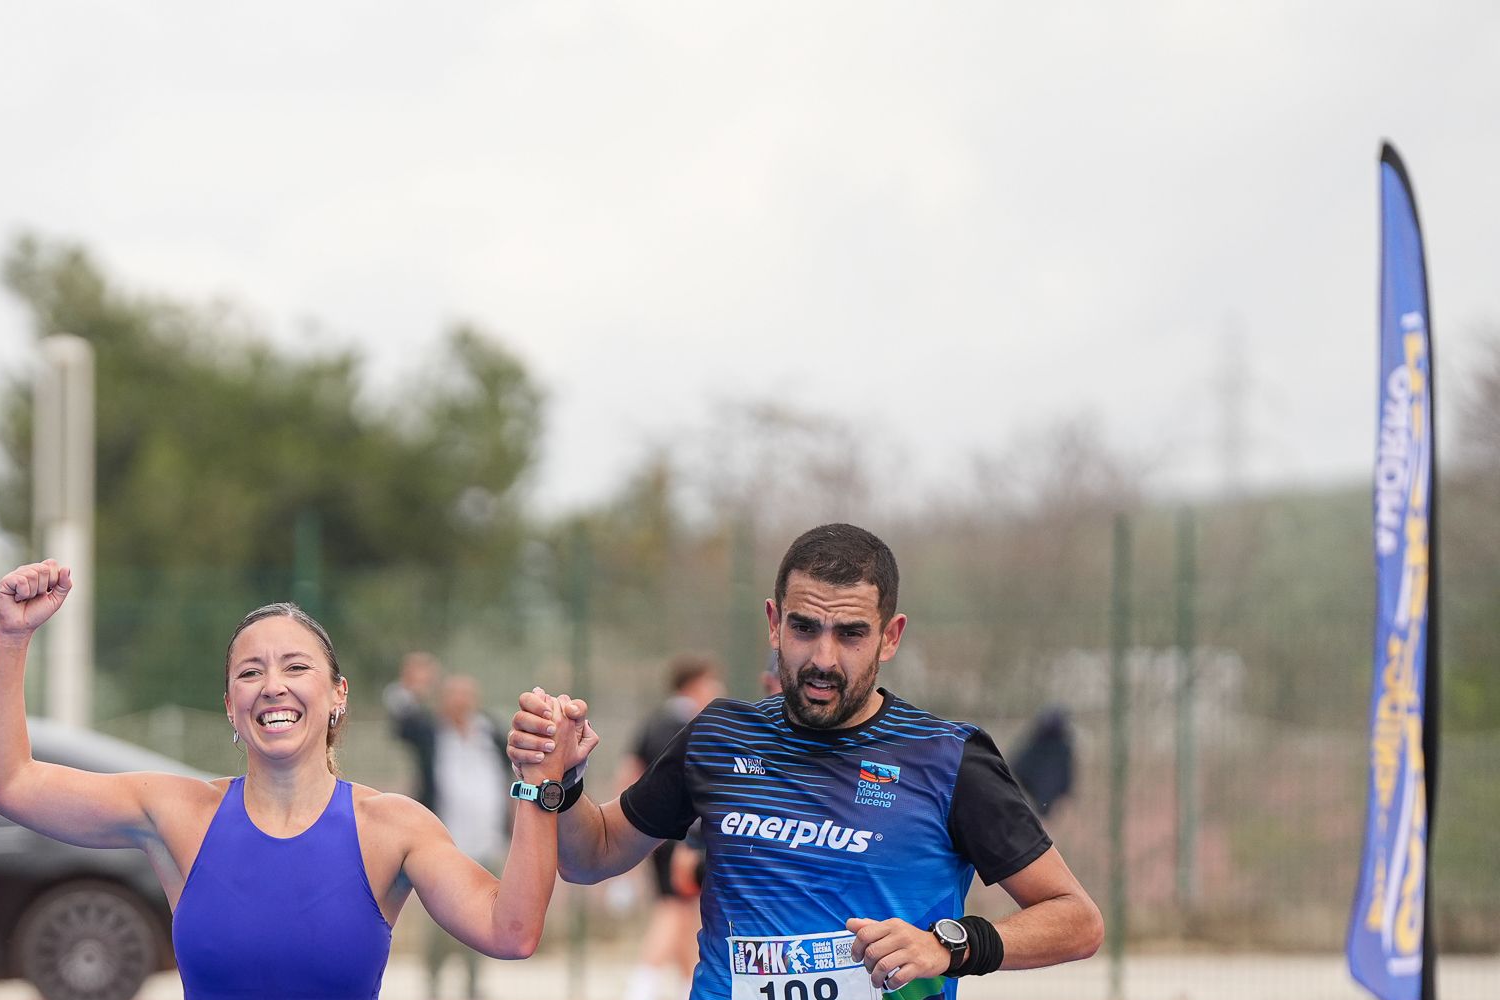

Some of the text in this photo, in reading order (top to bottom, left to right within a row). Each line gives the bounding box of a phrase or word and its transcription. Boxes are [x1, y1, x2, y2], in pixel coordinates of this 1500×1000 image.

[749, 766, 766, 775] PRO
[858, 780, 880, 791] Club
[856, 788, 896, 801] Maratón
[854, 796, 892, 808] Lucena
[720, 811, 873, 853] enerplus
[745, 942, 788, 974] 21K
[815, 959, 834, 969] 2026
